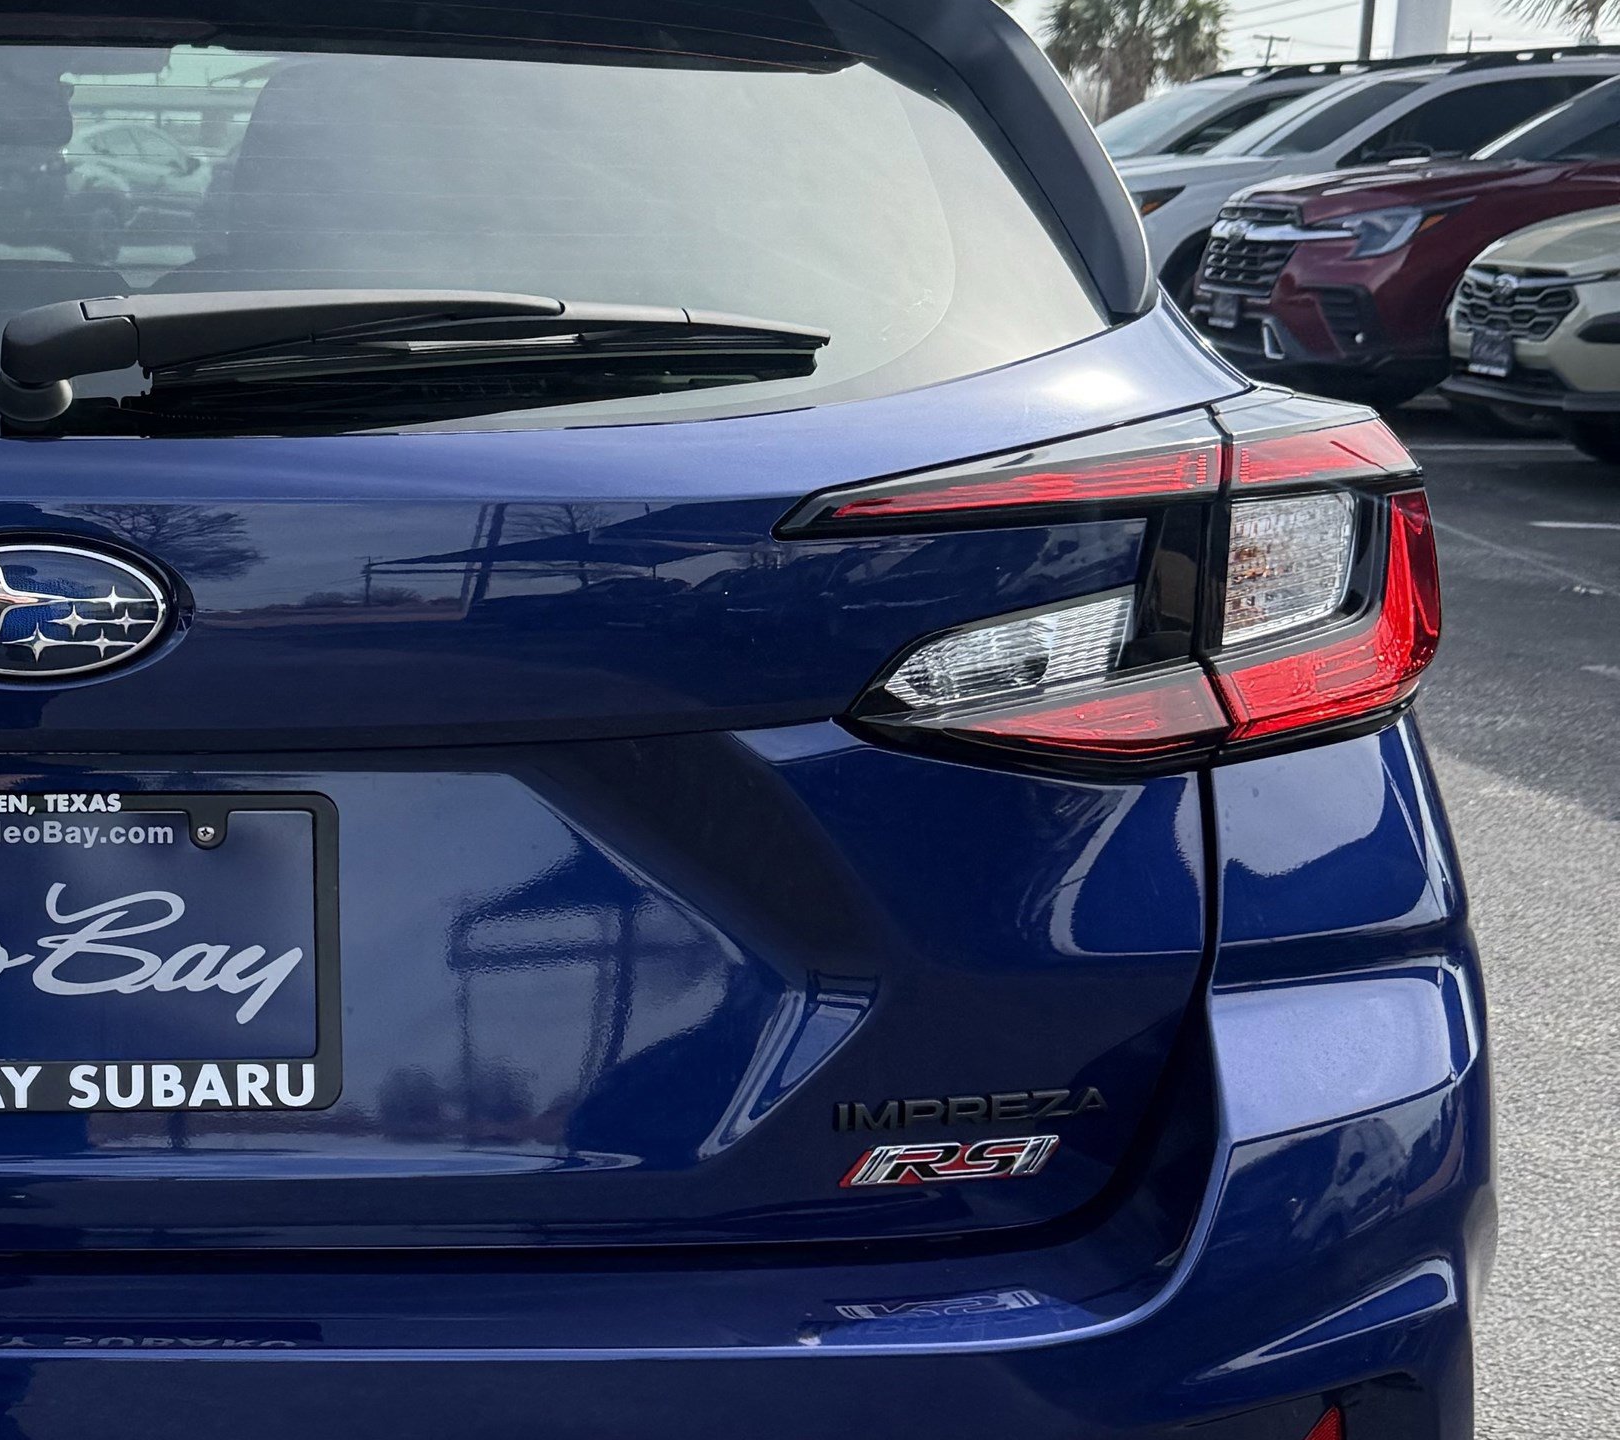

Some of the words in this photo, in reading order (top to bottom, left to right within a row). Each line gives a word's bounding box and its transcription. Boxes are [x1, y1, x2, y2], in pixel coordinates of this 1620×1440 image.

[44, 794, 122, 812] TEXAS
[32, 882, 302, 1024] Bay
[69, 1063, 316, 1108] SUBARU
[836, 1086, 1109, 1131] IMPREZA
